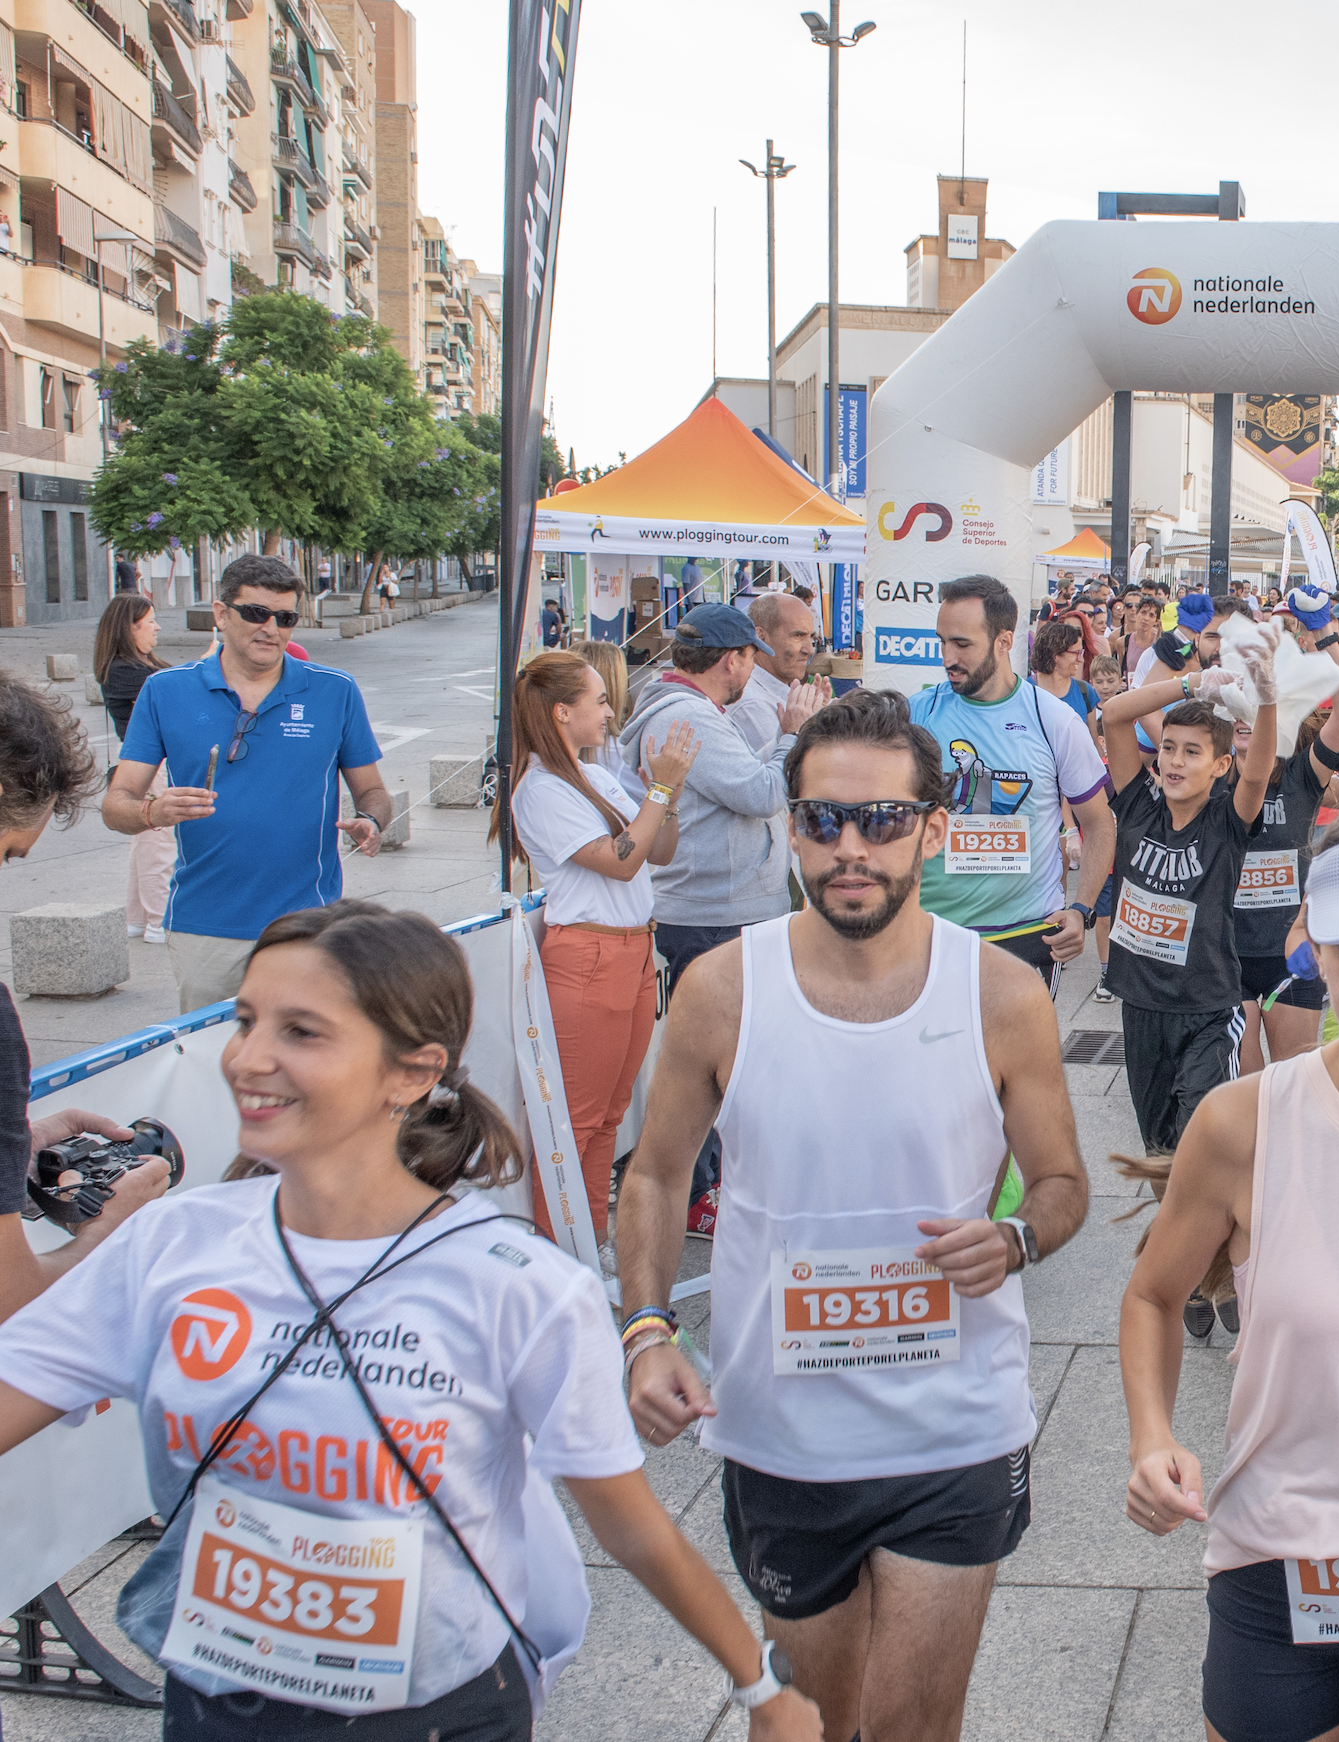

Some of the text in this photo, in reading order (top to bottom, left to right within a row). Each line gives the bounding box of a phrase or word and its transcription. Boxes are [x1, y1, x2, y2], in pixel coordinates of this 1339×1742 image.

[948, 237, 977, 245] málaga
[1193, 275, 1284, 292] nationale
[1193, 296, 1315, 314] nederlanden
[849, 399, 858, 430] PAISAJE
[849, 431, 858, 460] PROPIO
[1050, 481, 1058, 494] FOR
[962, 519, 994, 529] Consejo
[962, 528, 996, 537] Superior
[639, 528, 790, 545] www.ploggingtour.com
[962, 537, 1007, 547] de Deportes
[994, 772, 1027, 780] RAPACES
[956, 833, 1020, 851] 19263
[1240, 868, 1288, 887] 8856
[1124, 903, 1180, 937] 18857
[814, 1263, 849, 1271] nationale
[814, 1269, 861, 1279] nederlanden
[802, 1285, 931, 1327] 19316
[796, 1349, 941, 1369] #HAZDEPORTEPORELPLANETA
[291, 1535, 397, 1569] PLOGGING
[212, 1547, 380, 1637] 19383
